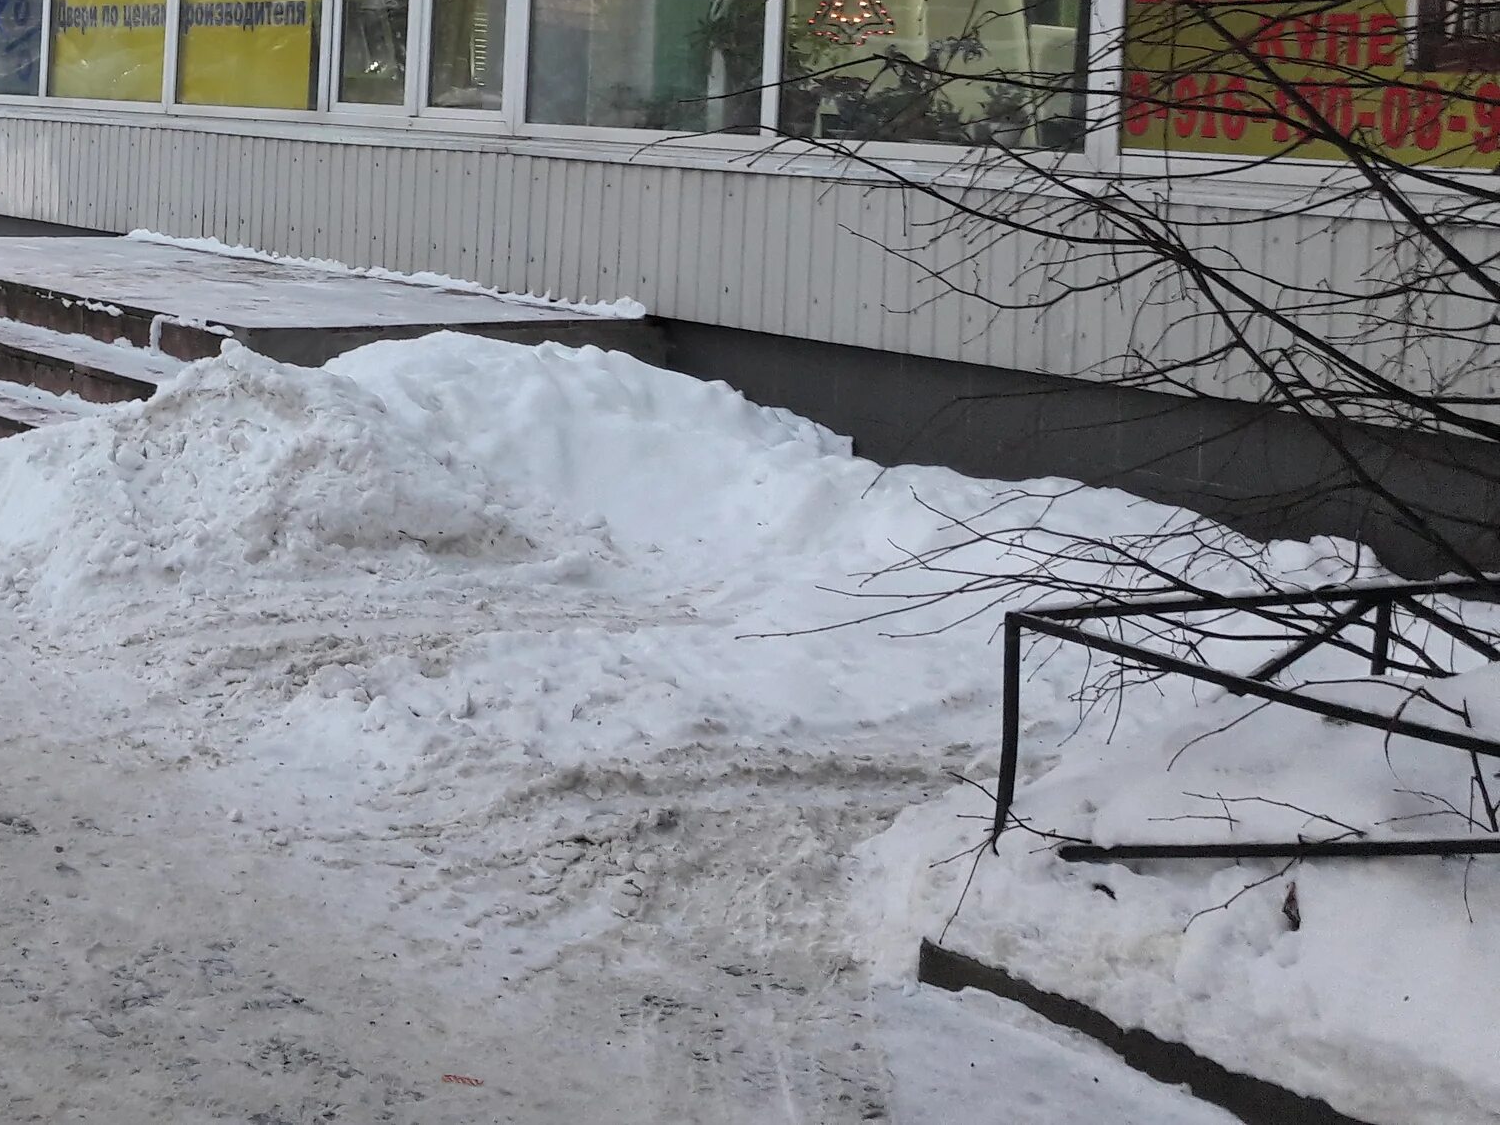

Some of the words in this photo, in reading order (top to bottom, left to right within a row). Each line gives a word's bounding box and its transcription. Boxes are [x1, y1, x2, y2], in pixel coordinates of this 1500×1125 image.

[58, 0, 98, 35] Двери
[101, 4, 120, 26] по
[1257, 14, 1398, 67] КУПЕ
